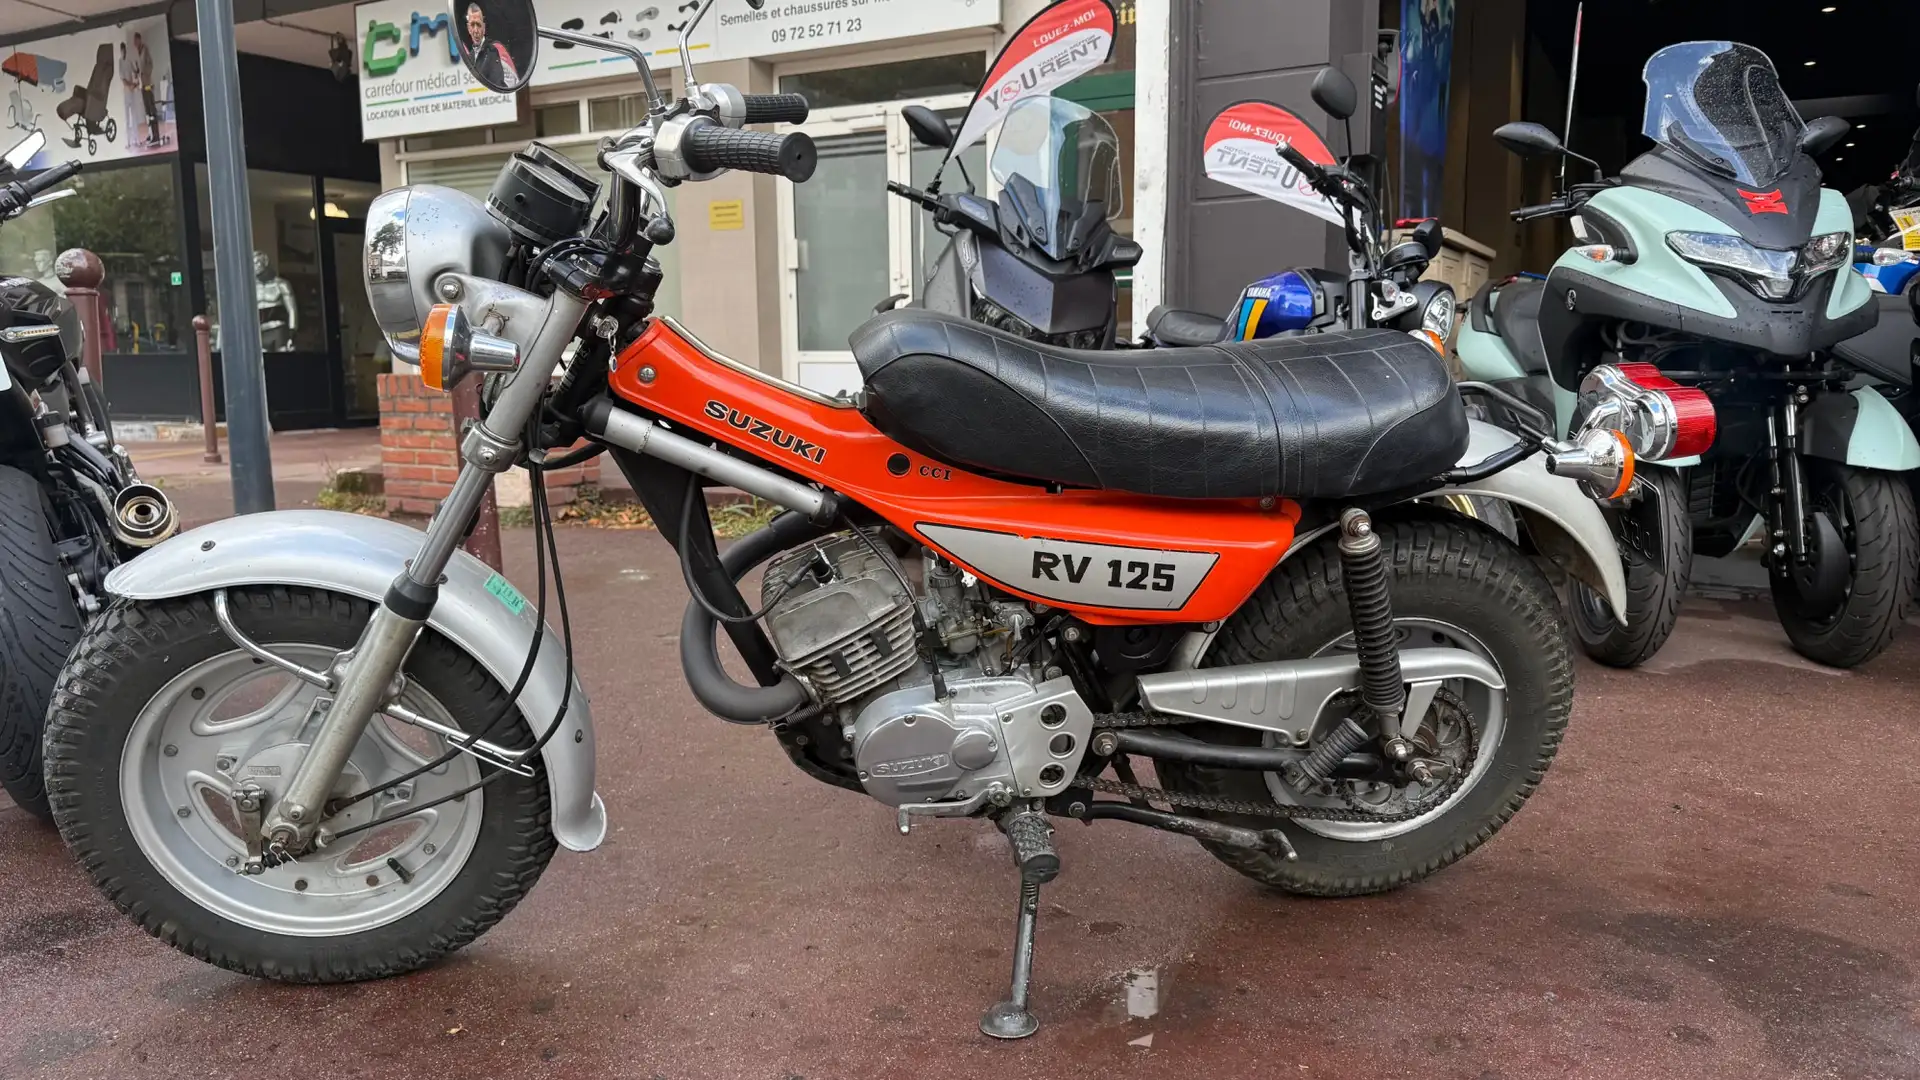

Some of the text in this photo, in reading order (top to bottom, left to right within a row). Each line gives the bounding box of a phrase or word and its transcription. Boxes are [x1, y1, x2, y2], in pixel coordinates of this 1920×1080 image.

[720, 9, 768, 26] Semelles
[771, 7, 781, 20] et
[784, 0, 848, 17] chaussures
[771, 18, 862, 43] 09 72 52 71 23
[1033, 9, 1096, 48] LOUEZ-MOI
[365, 78, 413, 99] carrefour
[416, 70, 461, 91] médical
[366, 109, 400, 121] LOCATION
[401, 109, 406, 117] &
[408, 105, 430, 116] VENTE
[431, 103, 442, 112] DE
[1246, 287, 1272, 298] YAMAHA
[704, 399, 827, 464] SUZUKI
[1031, 551, 1176, 592] RV 125
[874, 753, 946, 774] SUZUKI
